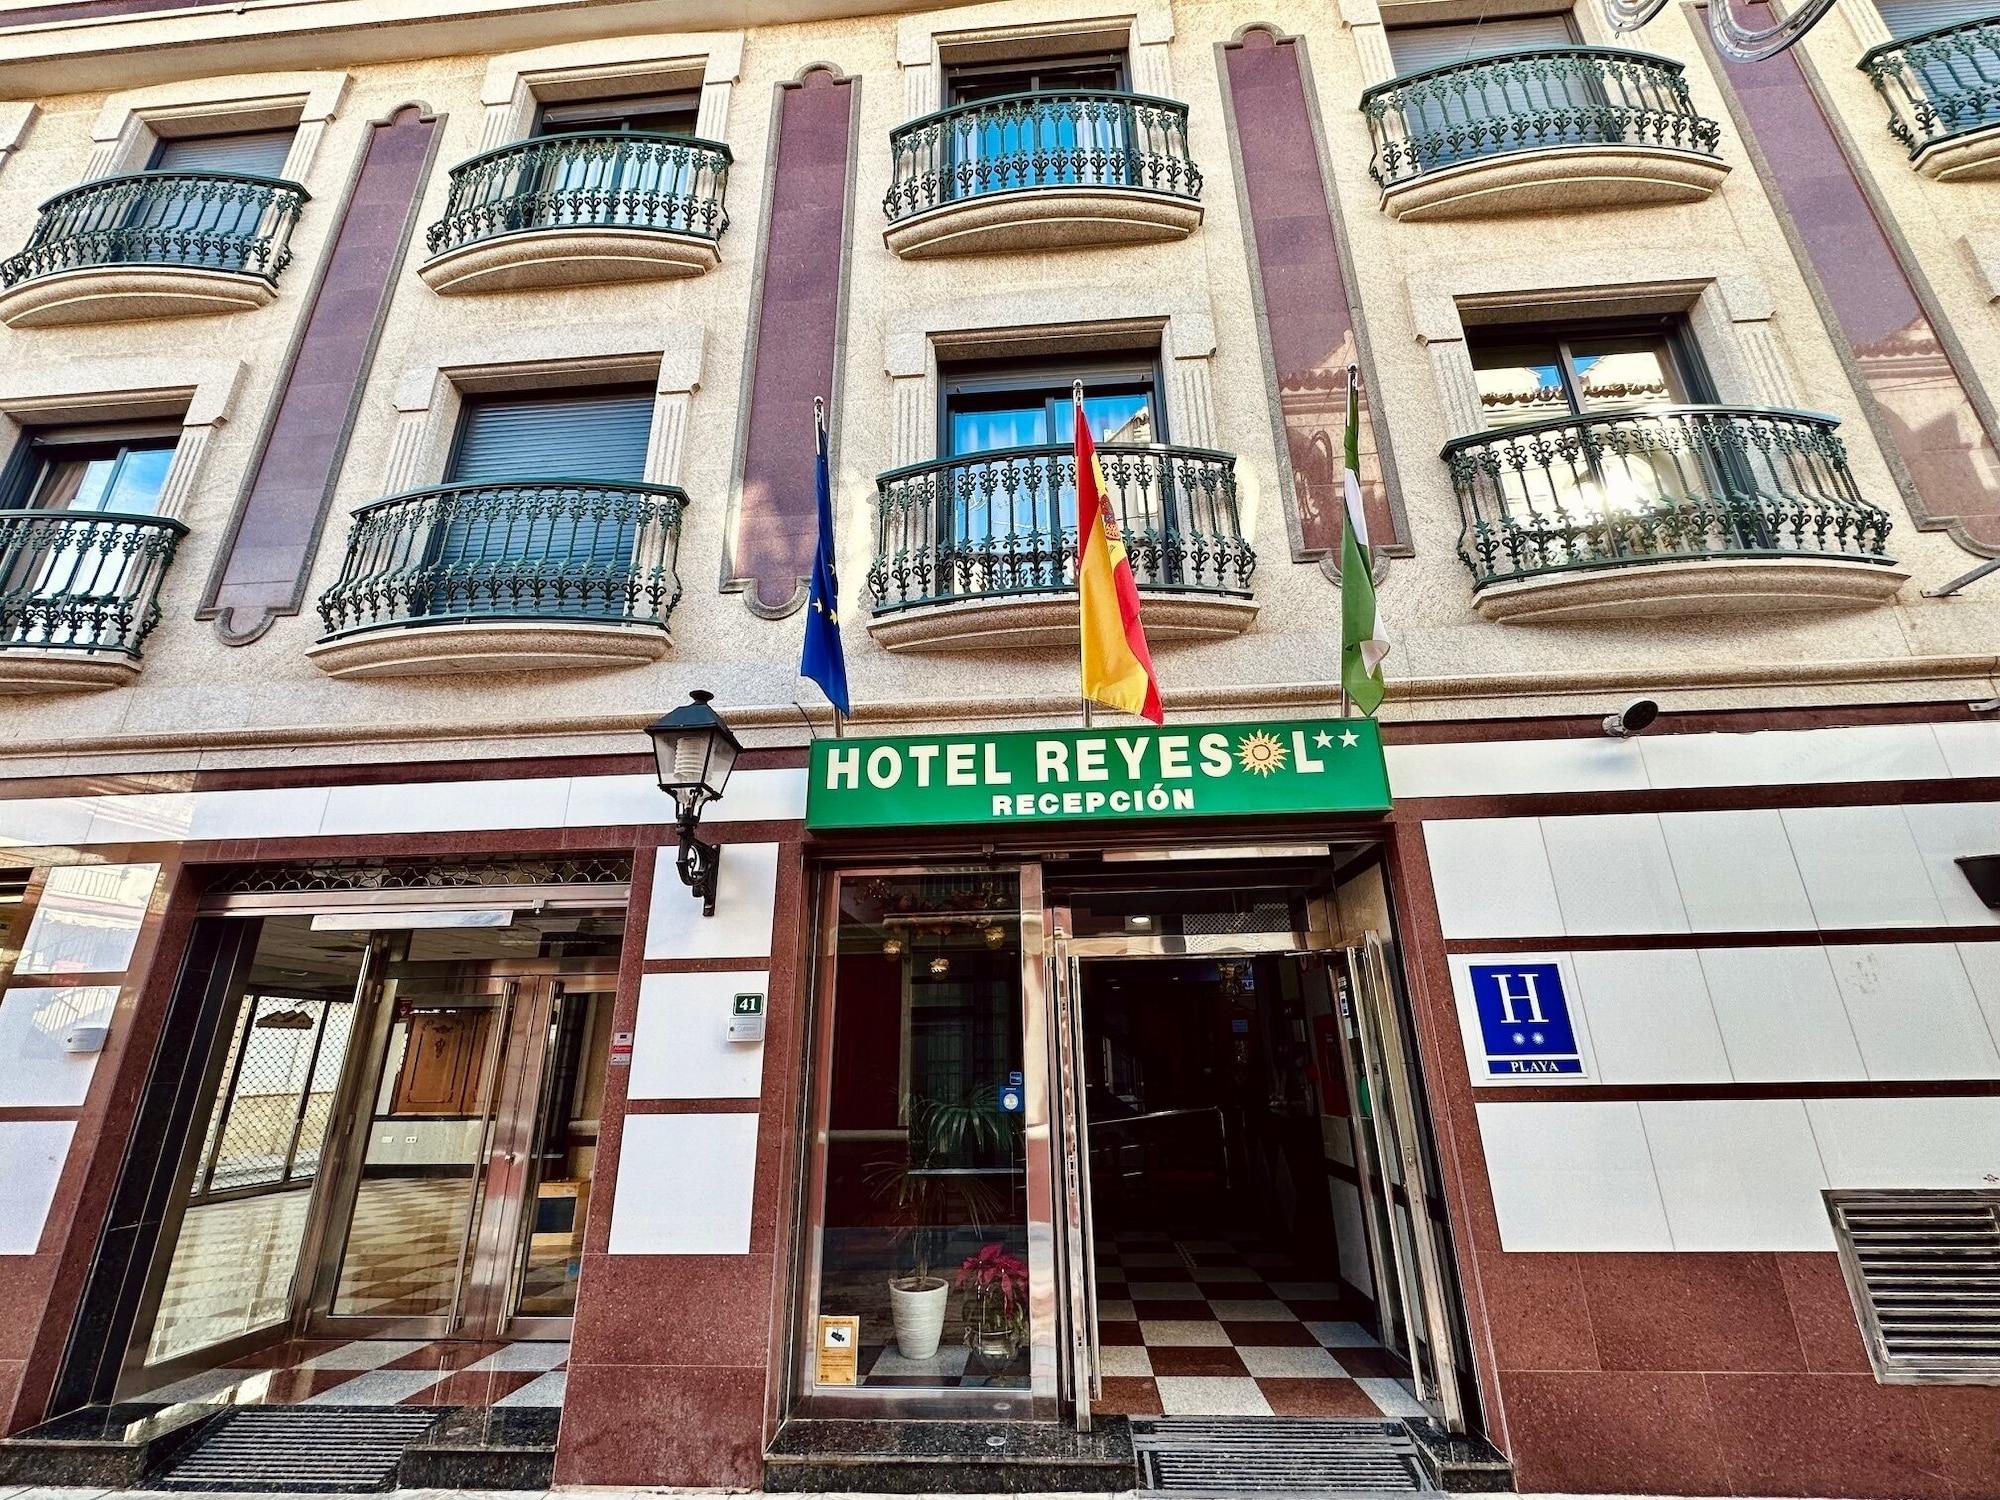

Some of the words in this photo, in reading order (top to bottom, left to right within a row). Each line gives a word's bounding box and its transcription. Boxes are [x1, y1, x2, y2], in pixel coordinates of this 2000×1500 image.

[826, 743, 1012, 790] HOTEL
[992, 782, 1195, 816] RECEPCIÓN
[739, 997, 756, 1011] 41
[1491, 973, 1550, 1024] H
[1510, 1060, 1559, 1073] PLAYA
